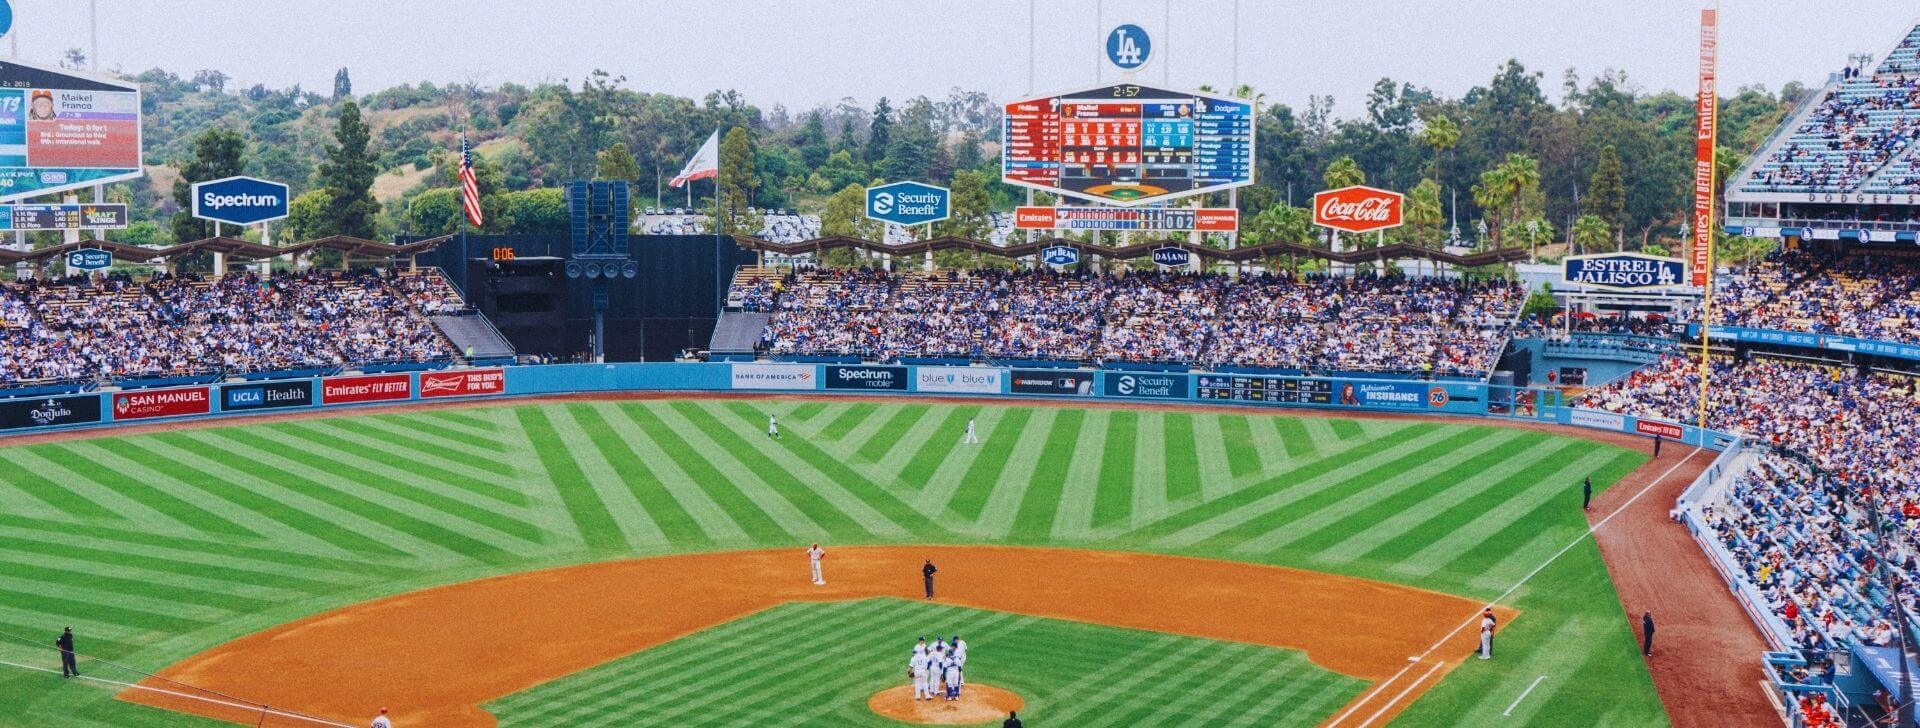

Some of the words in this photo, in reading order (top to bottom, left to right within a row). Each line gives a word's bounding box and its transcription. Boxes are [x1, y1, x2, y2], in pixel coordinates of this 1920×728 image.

[1117, 30, 1141, 64] LA
[1114, 87, 1140, 96] 2:57
[1214, 105, 1240, 114] Dodgers
[1698, 80, 1713, 140] Emirates
[1696, 160, 1711, 192] BETTER
[204, 192, 276, 210] Spectrum
[898, 192, 941, 205] Security
[1696, 194, 1710, 210] FLY
[898, 204, 935, 215] Benefit
[1321, 197, 1394, 222] Coca-Cola
[1166, 216, 1173, 228] 0
[1176, 216, 1183, 228] 0
[1186, 216, 1193, 228] 2
[1694, 213, 1708, 274] Emirates
[494, 248, 514, 260] 0:06
[1044, 249, 1057, 261] JIM
[1058, 248, 1076, 261] BEAM
[1155, 252, 1186, 261] DASANI
[1573, 271, 1653, 285] JALISCO
[839, 368, 890, 380] Spectrum
[922, 374, 944, 382] blue
[963, 374, 985, 383] blue
[1138, 376, 1175, 388] Security
[266, 388, 305, 400] Health
[326, 384, 370, 396] Emirates
[372, 384, 383, 393] FLY
[384, 381, 407, 392] BETTER
[1138, 386, 1169, 396] Benefit
[130, 395, 156, 405] SAN
[158, 392, 205, 403] MANUEL
[233, 392, 259, 402] UCLA
[1366, 392, 1419, 402] INSURANCE
[1430, 392, 1445, 403] 76
[131, 405, 161, 414] CASINO
